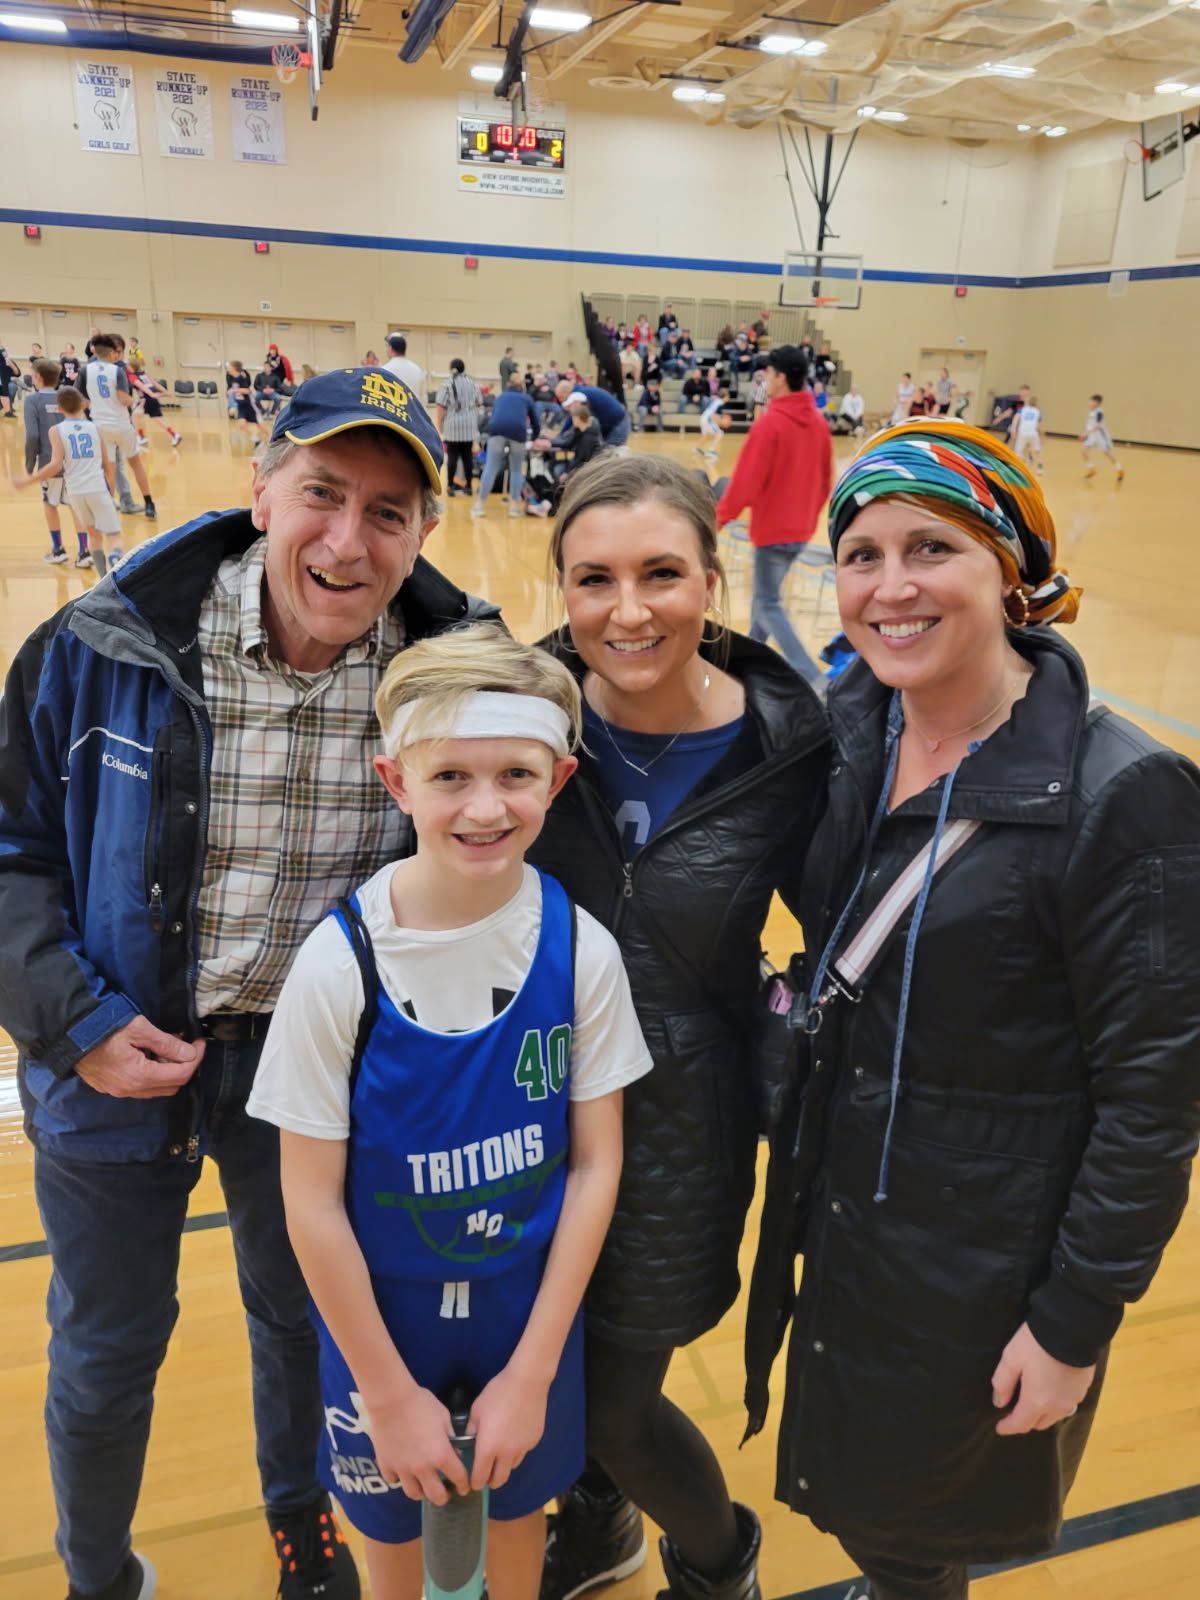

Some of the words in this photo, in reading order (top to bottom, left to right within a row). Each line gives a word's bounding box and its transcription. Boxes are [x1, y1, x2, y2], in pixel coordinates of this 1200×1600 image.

[88, 63, 119, 76] STATE
[166, 71, 196, 84] STATE
[77, 73, 131, 88] RUNNER-UP
[156, 80, 208, 95] RUNNER-UP
[241, 78, 270, 90] STATE
[231, 87, 281, 102] RUNNER-UP
[96, 374, 111, 399] 6
[360, 394, 409, 422] IRISH
[68, 433, 95, 460] 12
[104, 754, 148, 780] Columbia
[514, 1023, 572, 1102] 40
[407, 1123, 545, 1195] TRITONS
